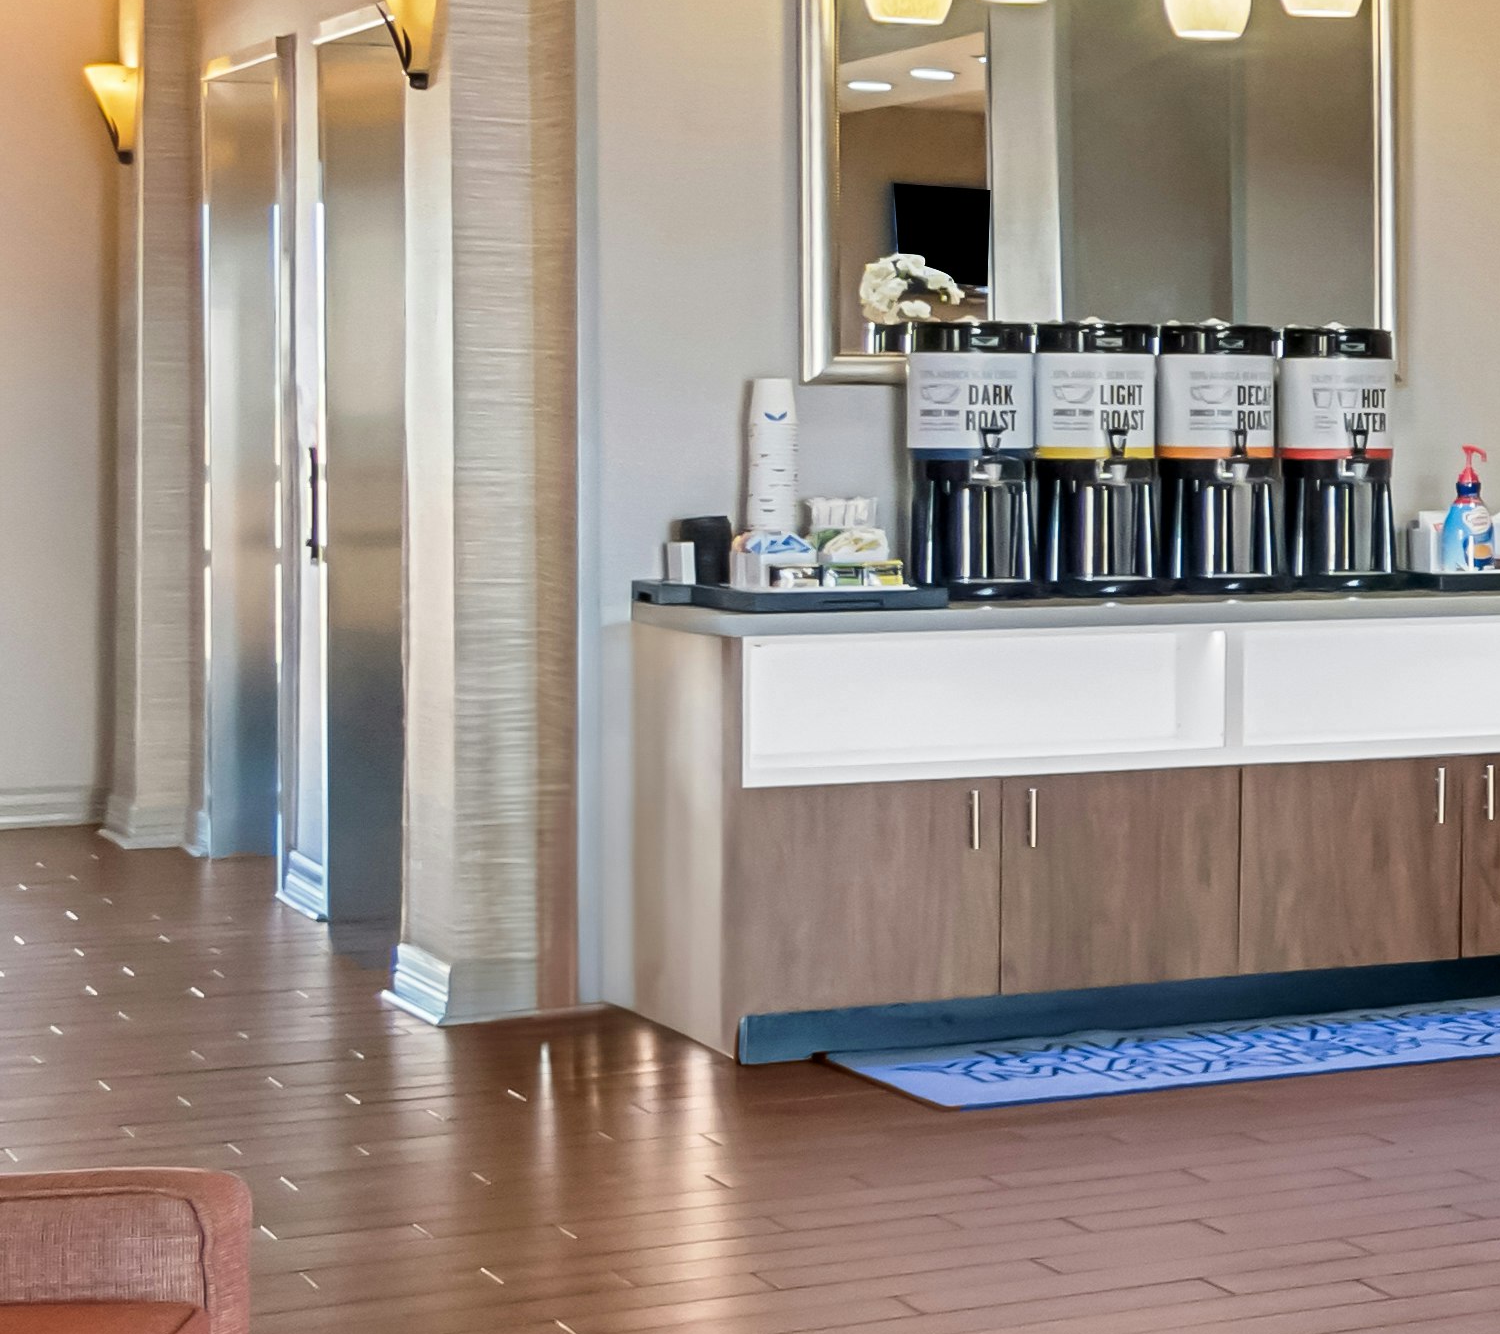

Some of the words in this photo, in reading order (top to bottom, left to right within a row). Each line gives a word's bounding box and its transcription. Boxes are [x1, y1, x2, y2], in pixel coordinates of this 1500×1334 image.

[968, 384, 1014, 406] DARK
[1100, 384, 1143, 406] LIGHT
[1361, 388, 1387, 409] HOT
[965, 409, 1017, 431] ROAST
[1100, 409, 1145, 431] ROAST
[1343, 412, 1387, 433] WATER
